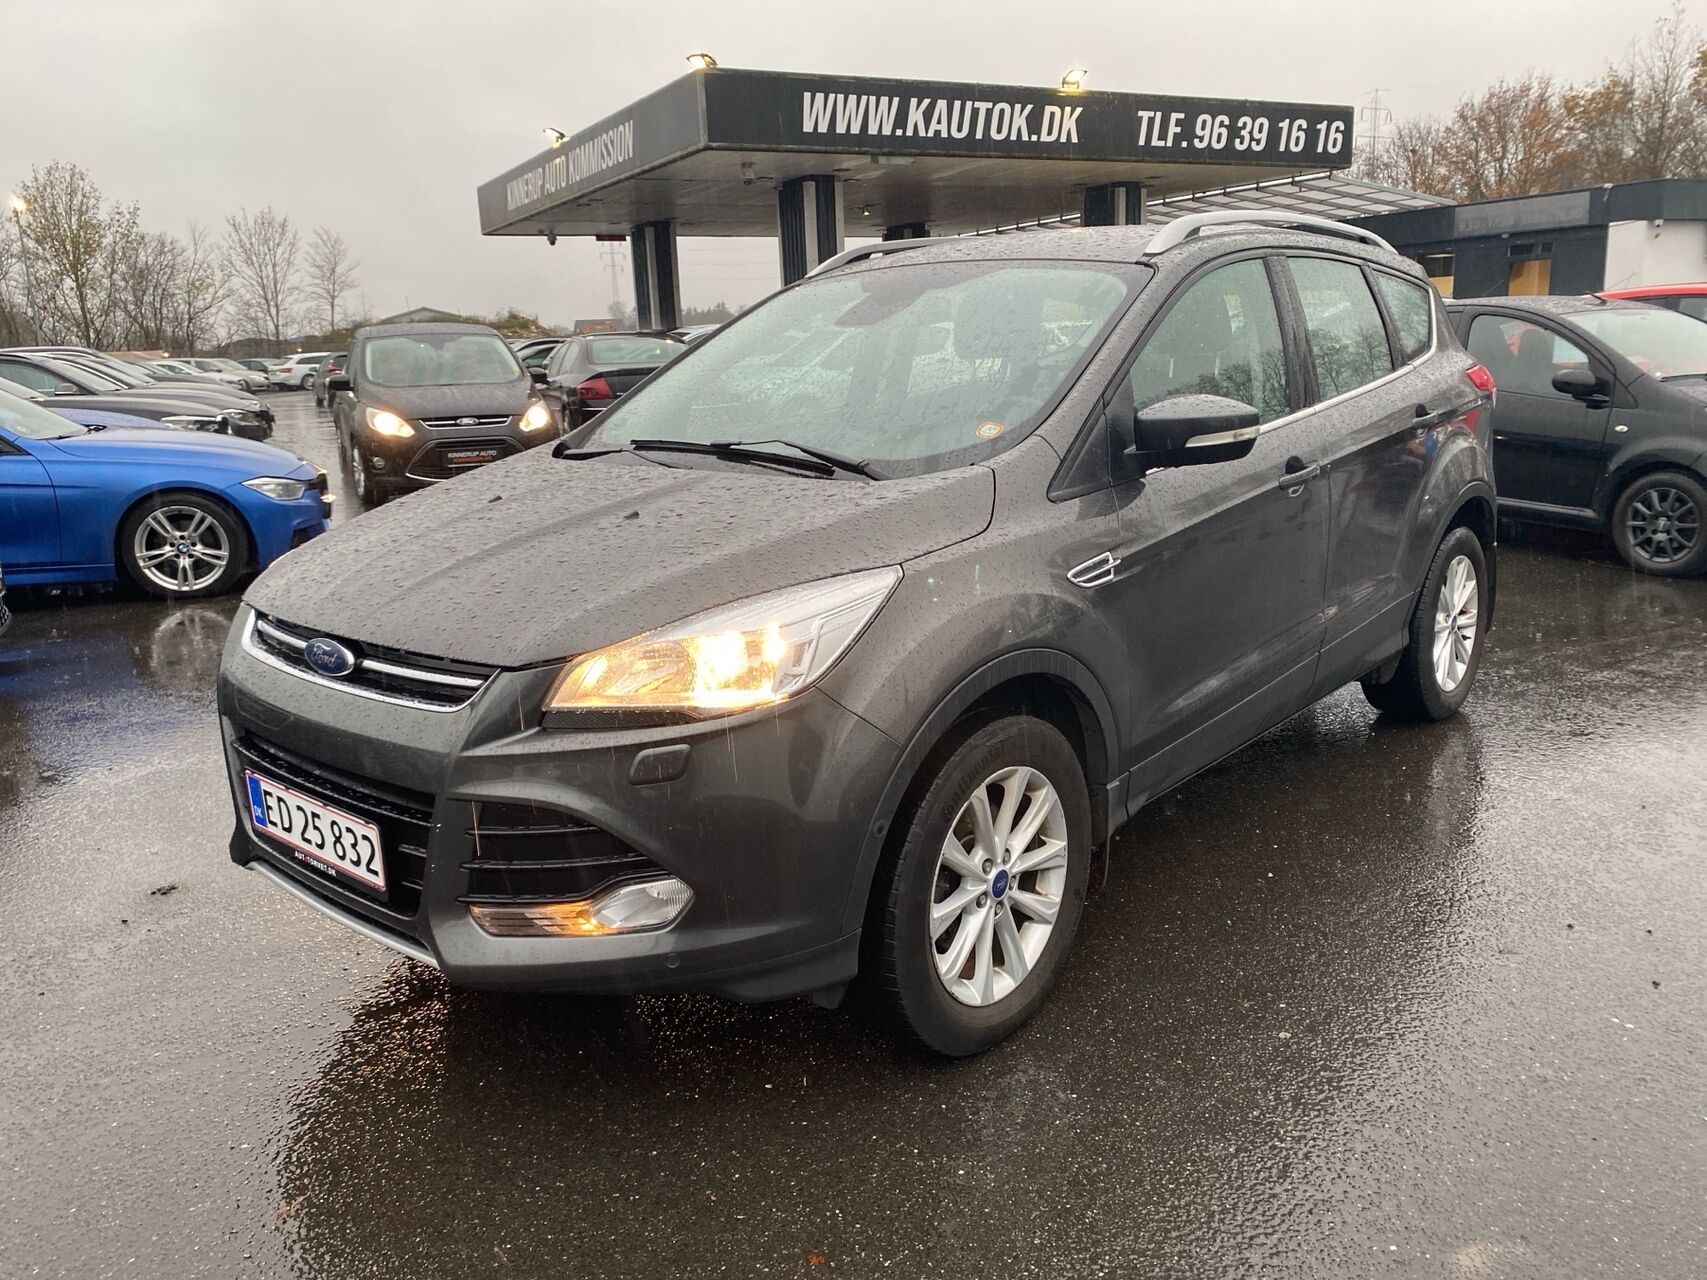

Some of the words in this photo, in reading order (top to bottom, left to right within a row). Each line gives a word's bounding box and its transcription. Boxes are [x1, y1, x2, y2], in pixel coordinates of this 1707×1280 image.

[802, 91, 1084, 144] WWW.KAUTOK.DK
[1137, 110, 1188, 148] TLF.
[1193, 113, 1230, 150] 96
[1234, 115, 1270, 152] 39
[1278, 118, 1308, 153] 16
[1315, 120, 1345, 154] 16
[506, 167, 543, 211] KINNERUP
[544, 154, 567, 195] AUTO
[568, 119, 633, 185] KOMMISSION
[310, 643, 337, 668] Ford
[253, 804, 264, 819] DK
[263, 788, 293, 834] ED
[295, 804, 325, 850] 25
[330, 819, 380, 877] 832
